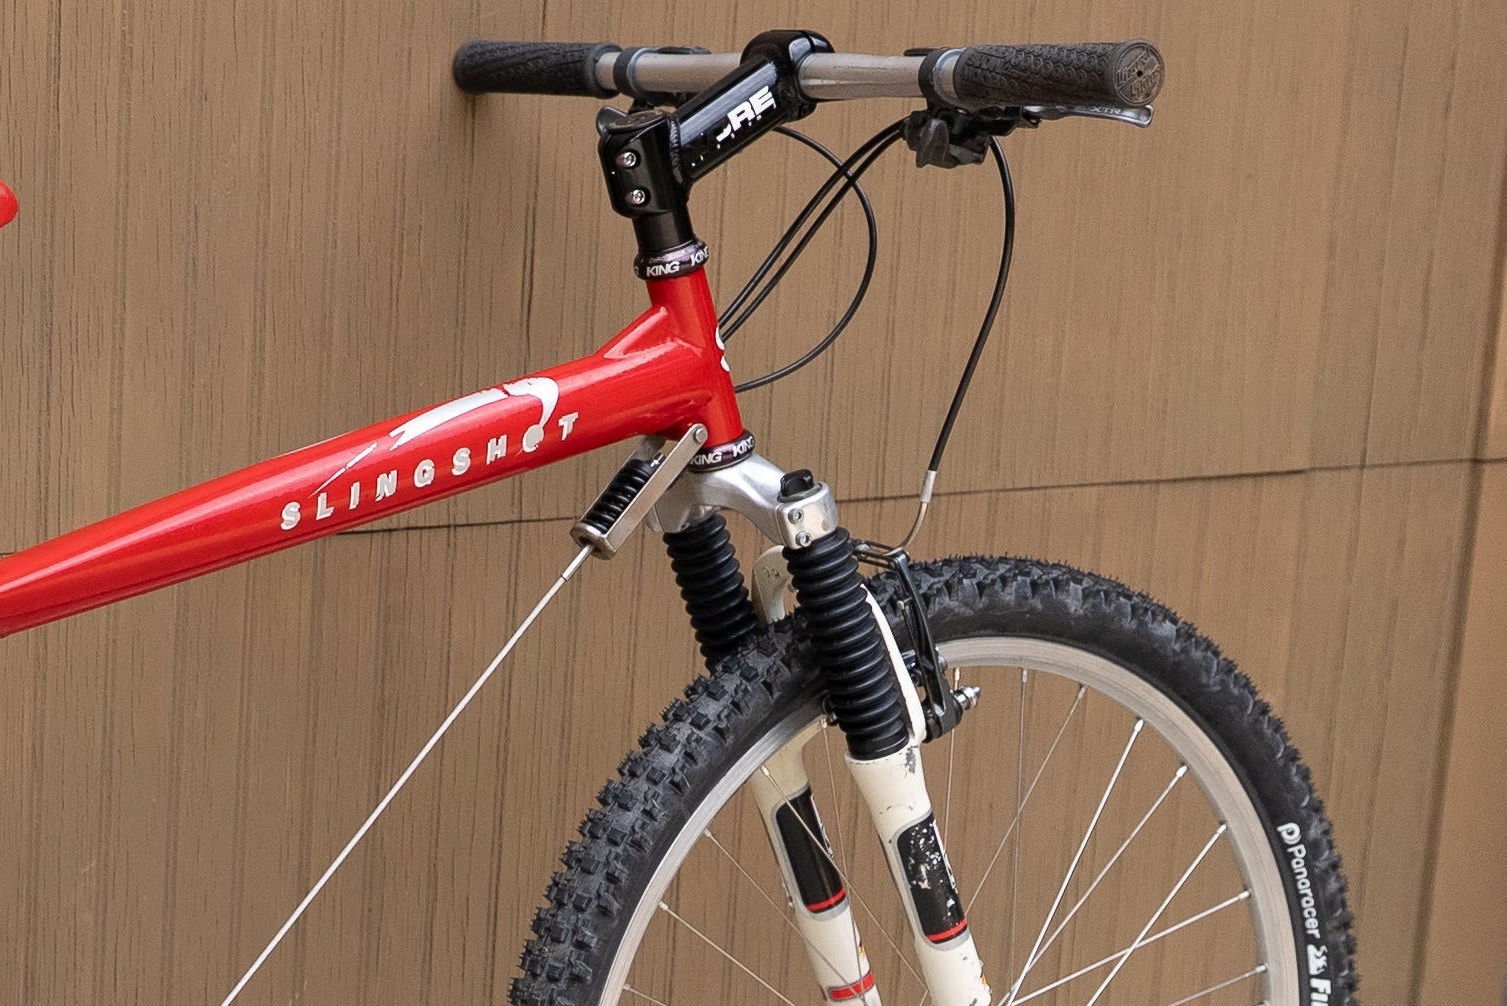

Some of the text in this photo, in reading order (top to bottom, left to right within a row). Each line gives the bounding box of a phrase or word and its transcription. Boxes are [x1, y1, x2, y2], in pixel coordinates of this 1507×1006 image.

[646, 260, 681, 278] KING
[281, 412, 580, 531] SLINGSHOT
[1286, 844, 1321, 939] Panaracer
